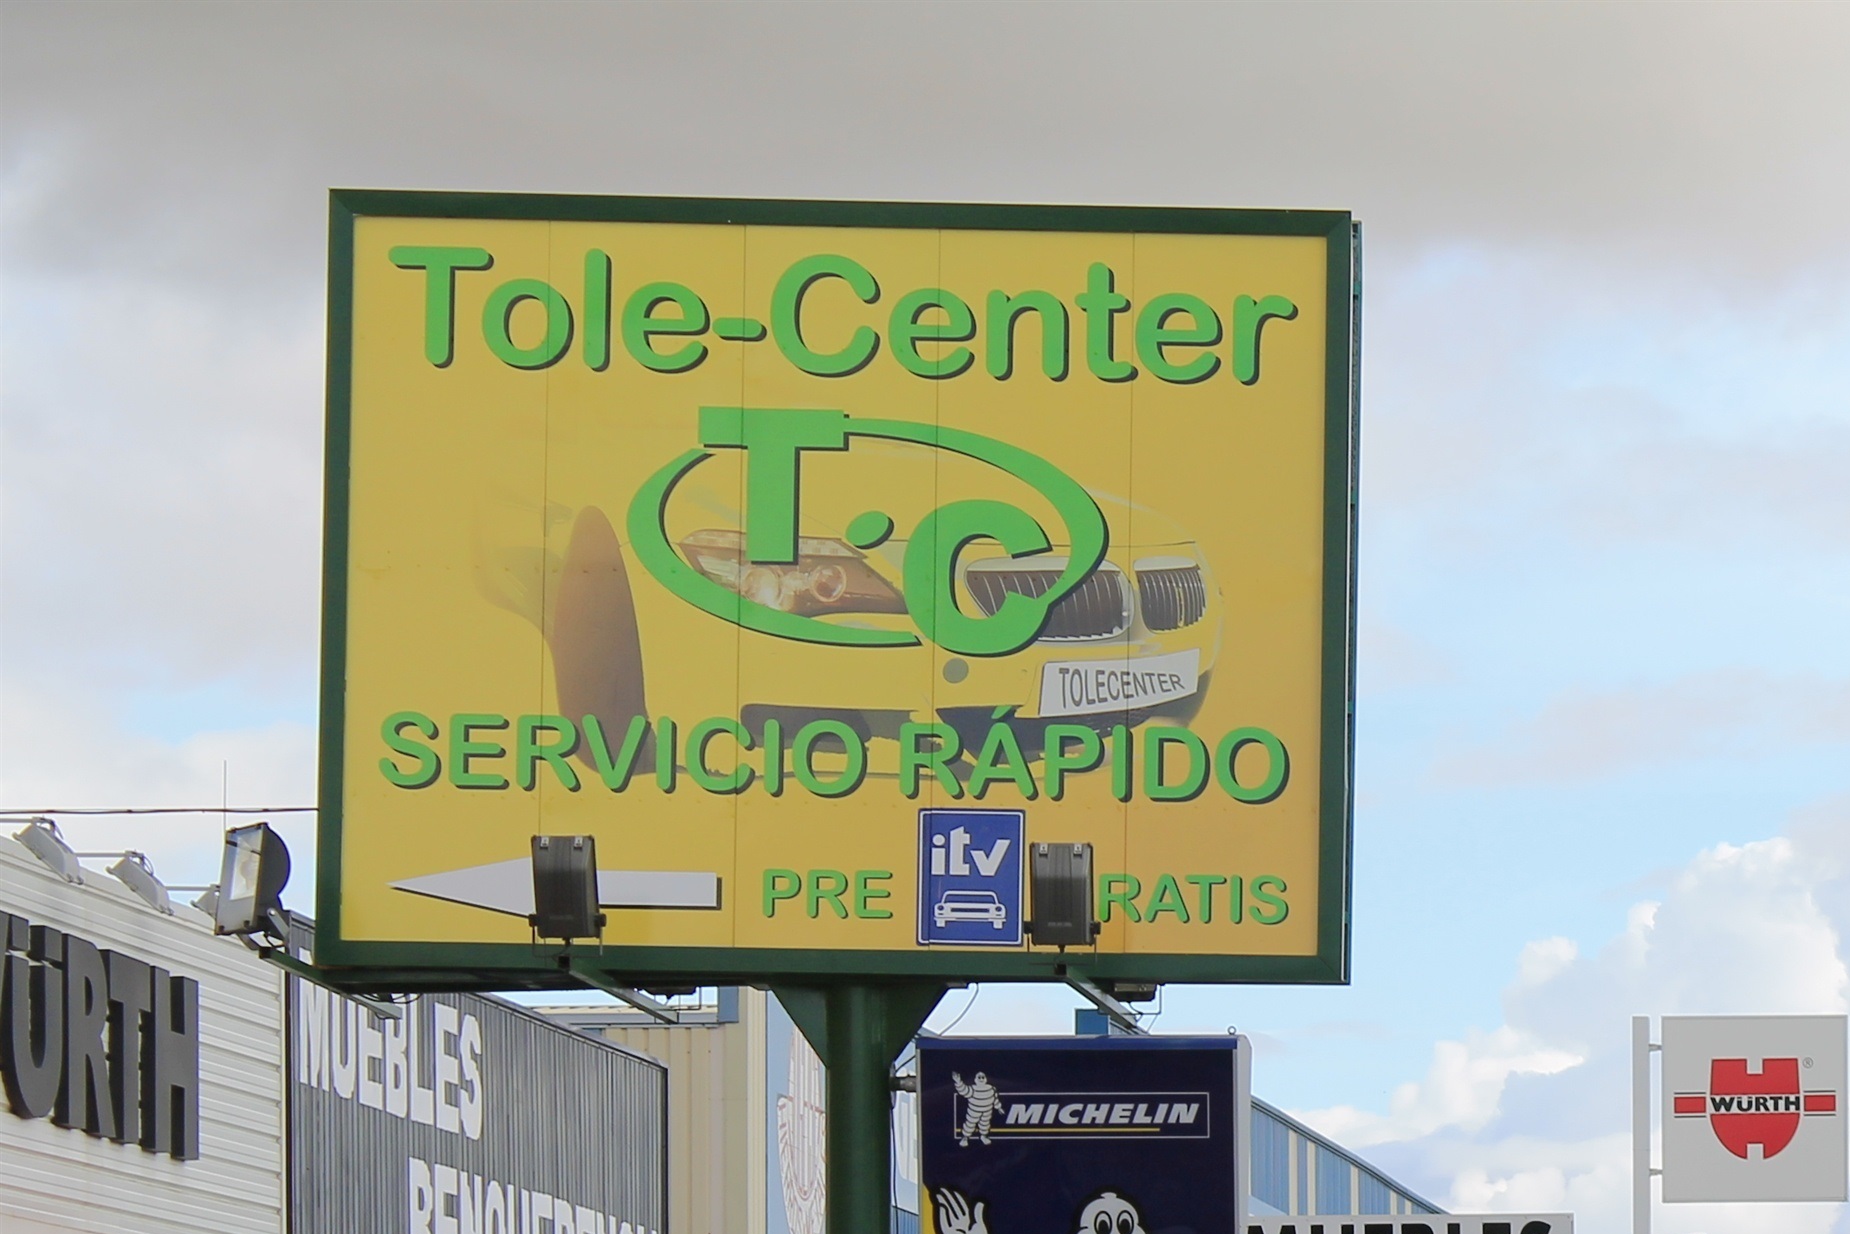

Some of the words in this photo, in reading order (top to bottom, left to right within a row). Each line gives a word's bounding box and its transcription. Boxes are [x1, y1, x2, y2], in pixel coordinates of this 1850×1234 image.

[388, 246, 1299, 384] Tole-Center
[1057, 666, 1187, 698] TOLECENTER
[378, 709, 867, 795] SERVICIO
[898, 706, 1290, 802] RÁPIDO
[762, 868, 893, 919] PRE
[931, 826, 1011, 877] itv
[1099, 873, 1290, 924] RATIS
[0, 910, 199, 1160] ÜRTH
[299, 946, 483, 1141] MUEBLES
[1004, 1102, 1200, 1126] MICHELIN
[1710, 1095, 1800, 1112] WÜRTH
